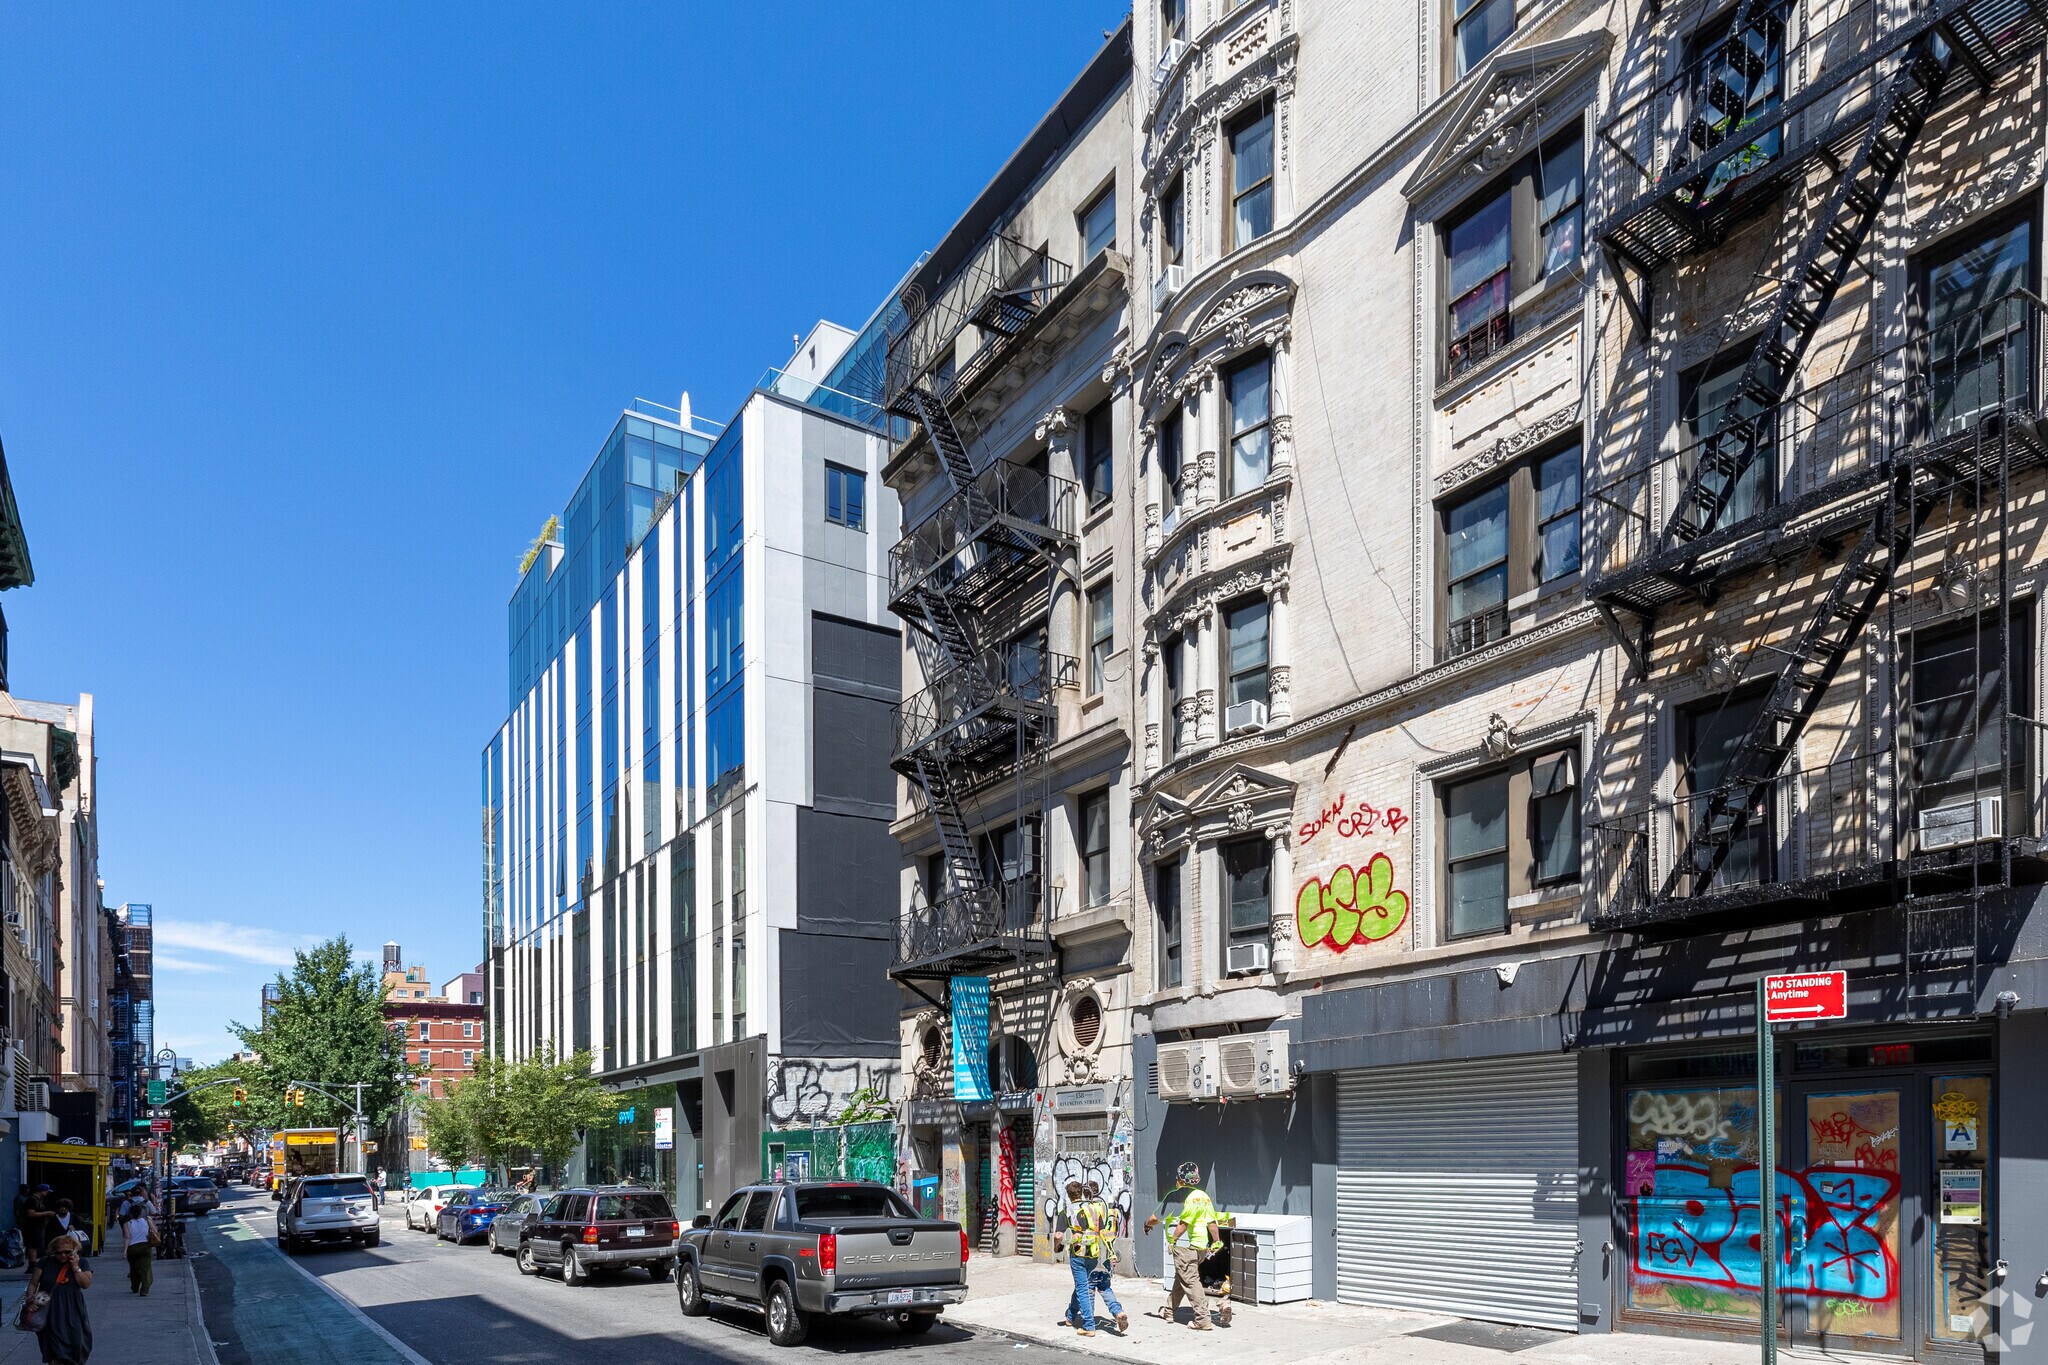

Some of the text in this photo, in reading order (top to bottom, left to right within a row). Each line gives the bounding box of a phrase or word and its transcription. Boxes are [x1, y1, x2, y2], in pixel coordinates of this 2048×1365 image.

[1770, 977, 1832, 990] NO STANDING
[1771, 989, 1809, 1001] Anytime
[1950, 1121, 1971, 1141] A
[926, 1186, 933, 1198] P
[843, 1251, 955, 1265] CHEVROLET
